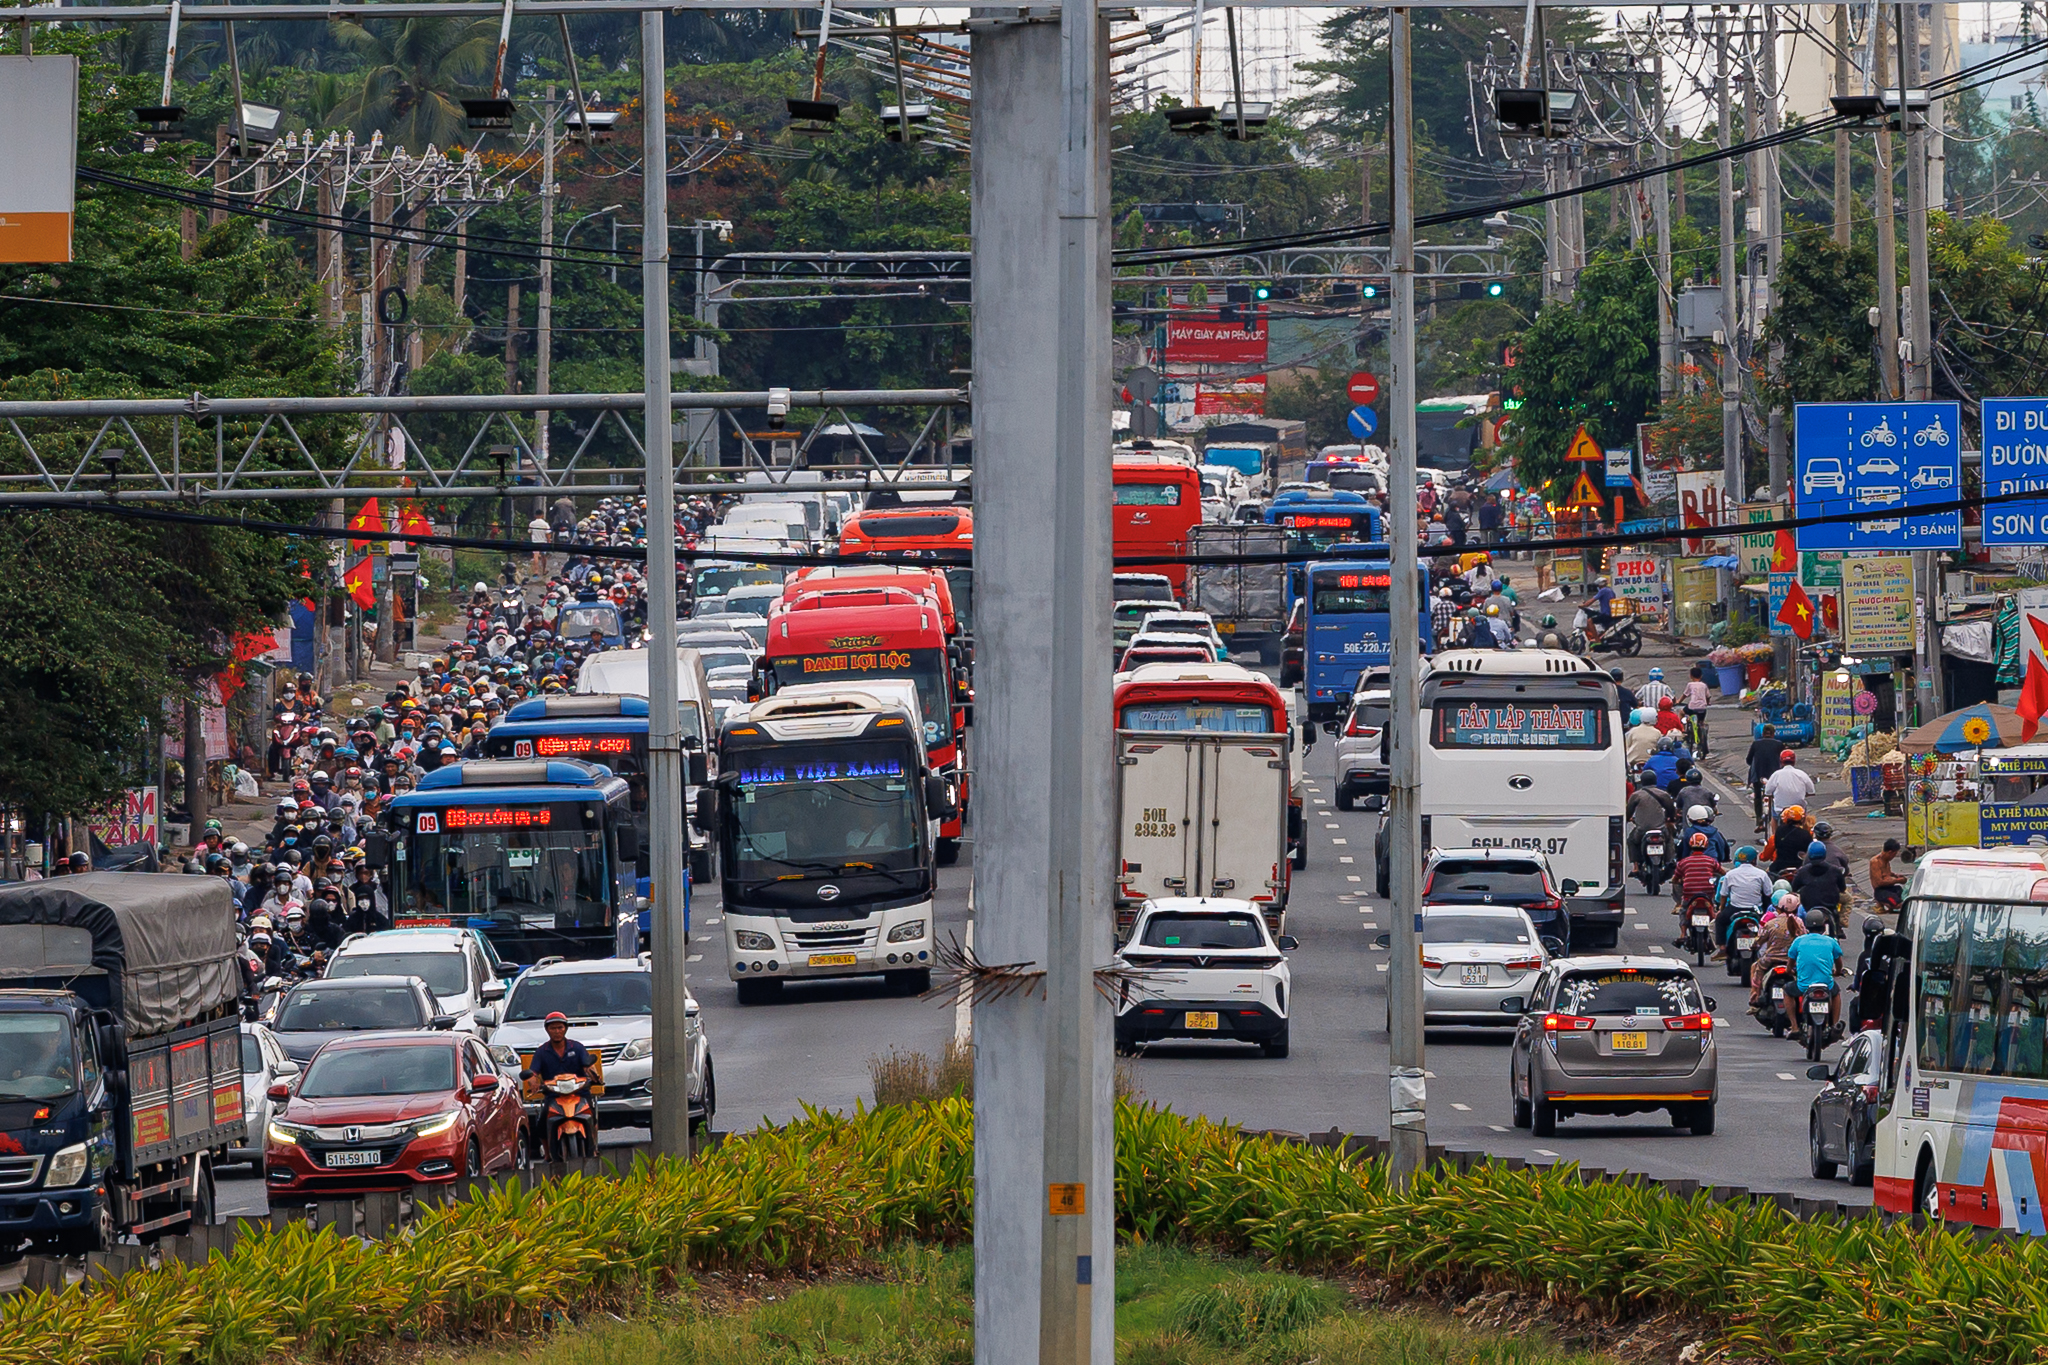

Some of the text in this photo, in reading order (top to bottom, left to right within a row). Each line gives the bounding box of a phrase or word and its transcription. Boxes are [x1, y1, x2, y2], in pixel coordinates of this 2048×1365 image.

[1996, 411, 2016, 430] ĐI
[1909, 522, 1957, 535] 3 BÁNH
[1992, 513, 2034, 535] SƠN
[804, 650, 911, 673] DANH LỢI LỘC
[1458, 702, 1584, 732] TÂN LẬP THÀNH
[516, 743, 531, 757] 09
[2023, 761, 2047, 770] PHA
[1143, 808, 1167, 822] 50H
[1982, 806, 1997, 818] CÀ
[1999, 805, 2021, 818] PHÊ
[420, 815, 437, 832] 09
[1134, 823, 1176, 837] 232.32
[1991, 822, 2009, 831] MY
[2010, 821, 2027, 831] MY
[1471, 837, 1568, 854] 66H-058.97
[327, 1152, 379, 1165] 51H-591.10
